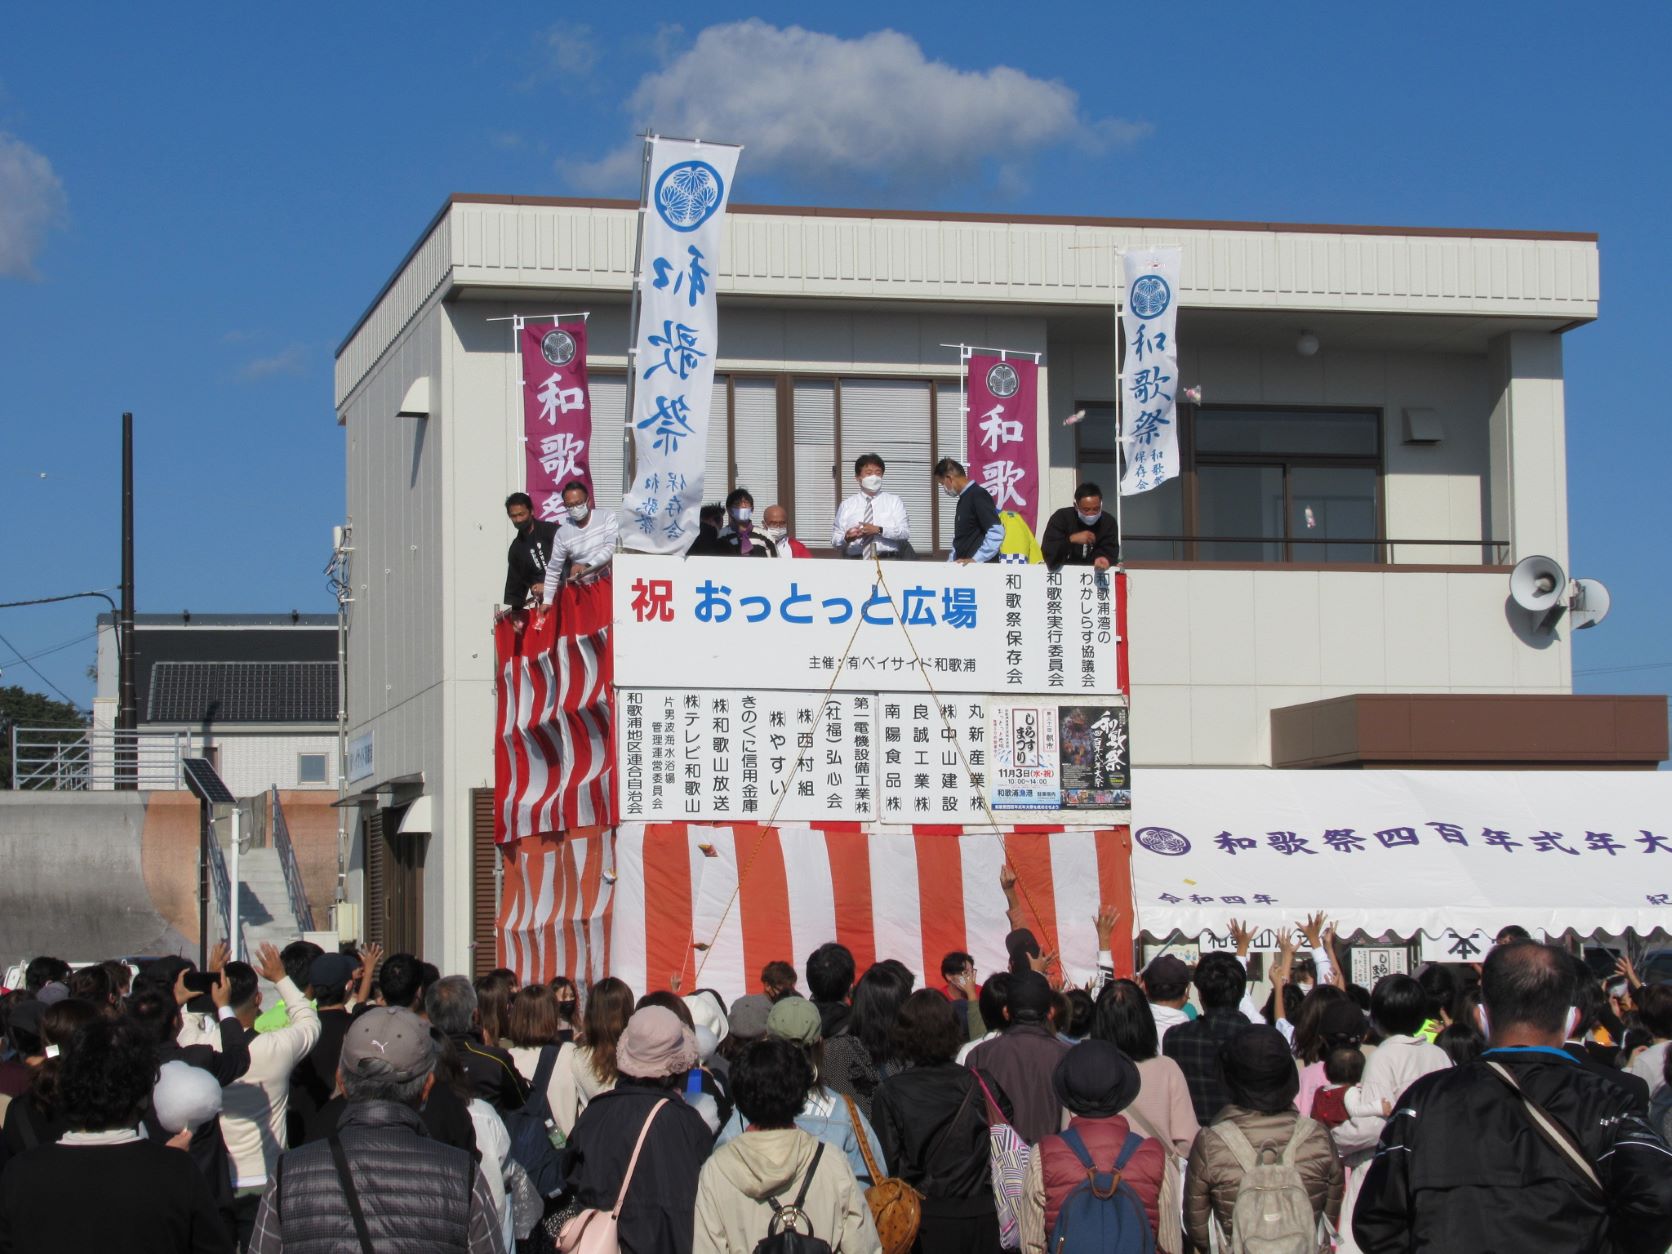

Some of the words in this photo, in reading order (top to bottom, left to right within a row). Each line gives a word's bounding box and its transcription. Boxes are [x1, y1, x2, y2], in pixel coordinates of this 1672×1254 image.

[1129, 323, 1172, 446] 和歌祭
[1134, 450, 1149, 490] 保存会
[631, 577, 675, 623] 祝
[695, 579, 979, 629] おっとっと広場
[1005, 573, 1023, 685] 和歌祭保存会
[1046, 572, 1064, 688] 和歌祭実行委員会
[1080, 572, 1096, 688] わかしらす協議会
[626, 691, 643, 815] 和歌浦地区連合自治会
[651, 721, 664, 810] 管理運営委員会
[664, 696, 676, 785] 片男波海水浴場
[741, 694, 758, 814] きのくに信用金庫
[1015, 726, 1026, 764] まつり
[1025, 712, 1036, 752] しらす
[1091, 710, 1127, 772] 和歌祭
[1212, 820, 1672, 856] 和歌祭四百年式年大
[1157, 892, 1280, 906] 令和四年
